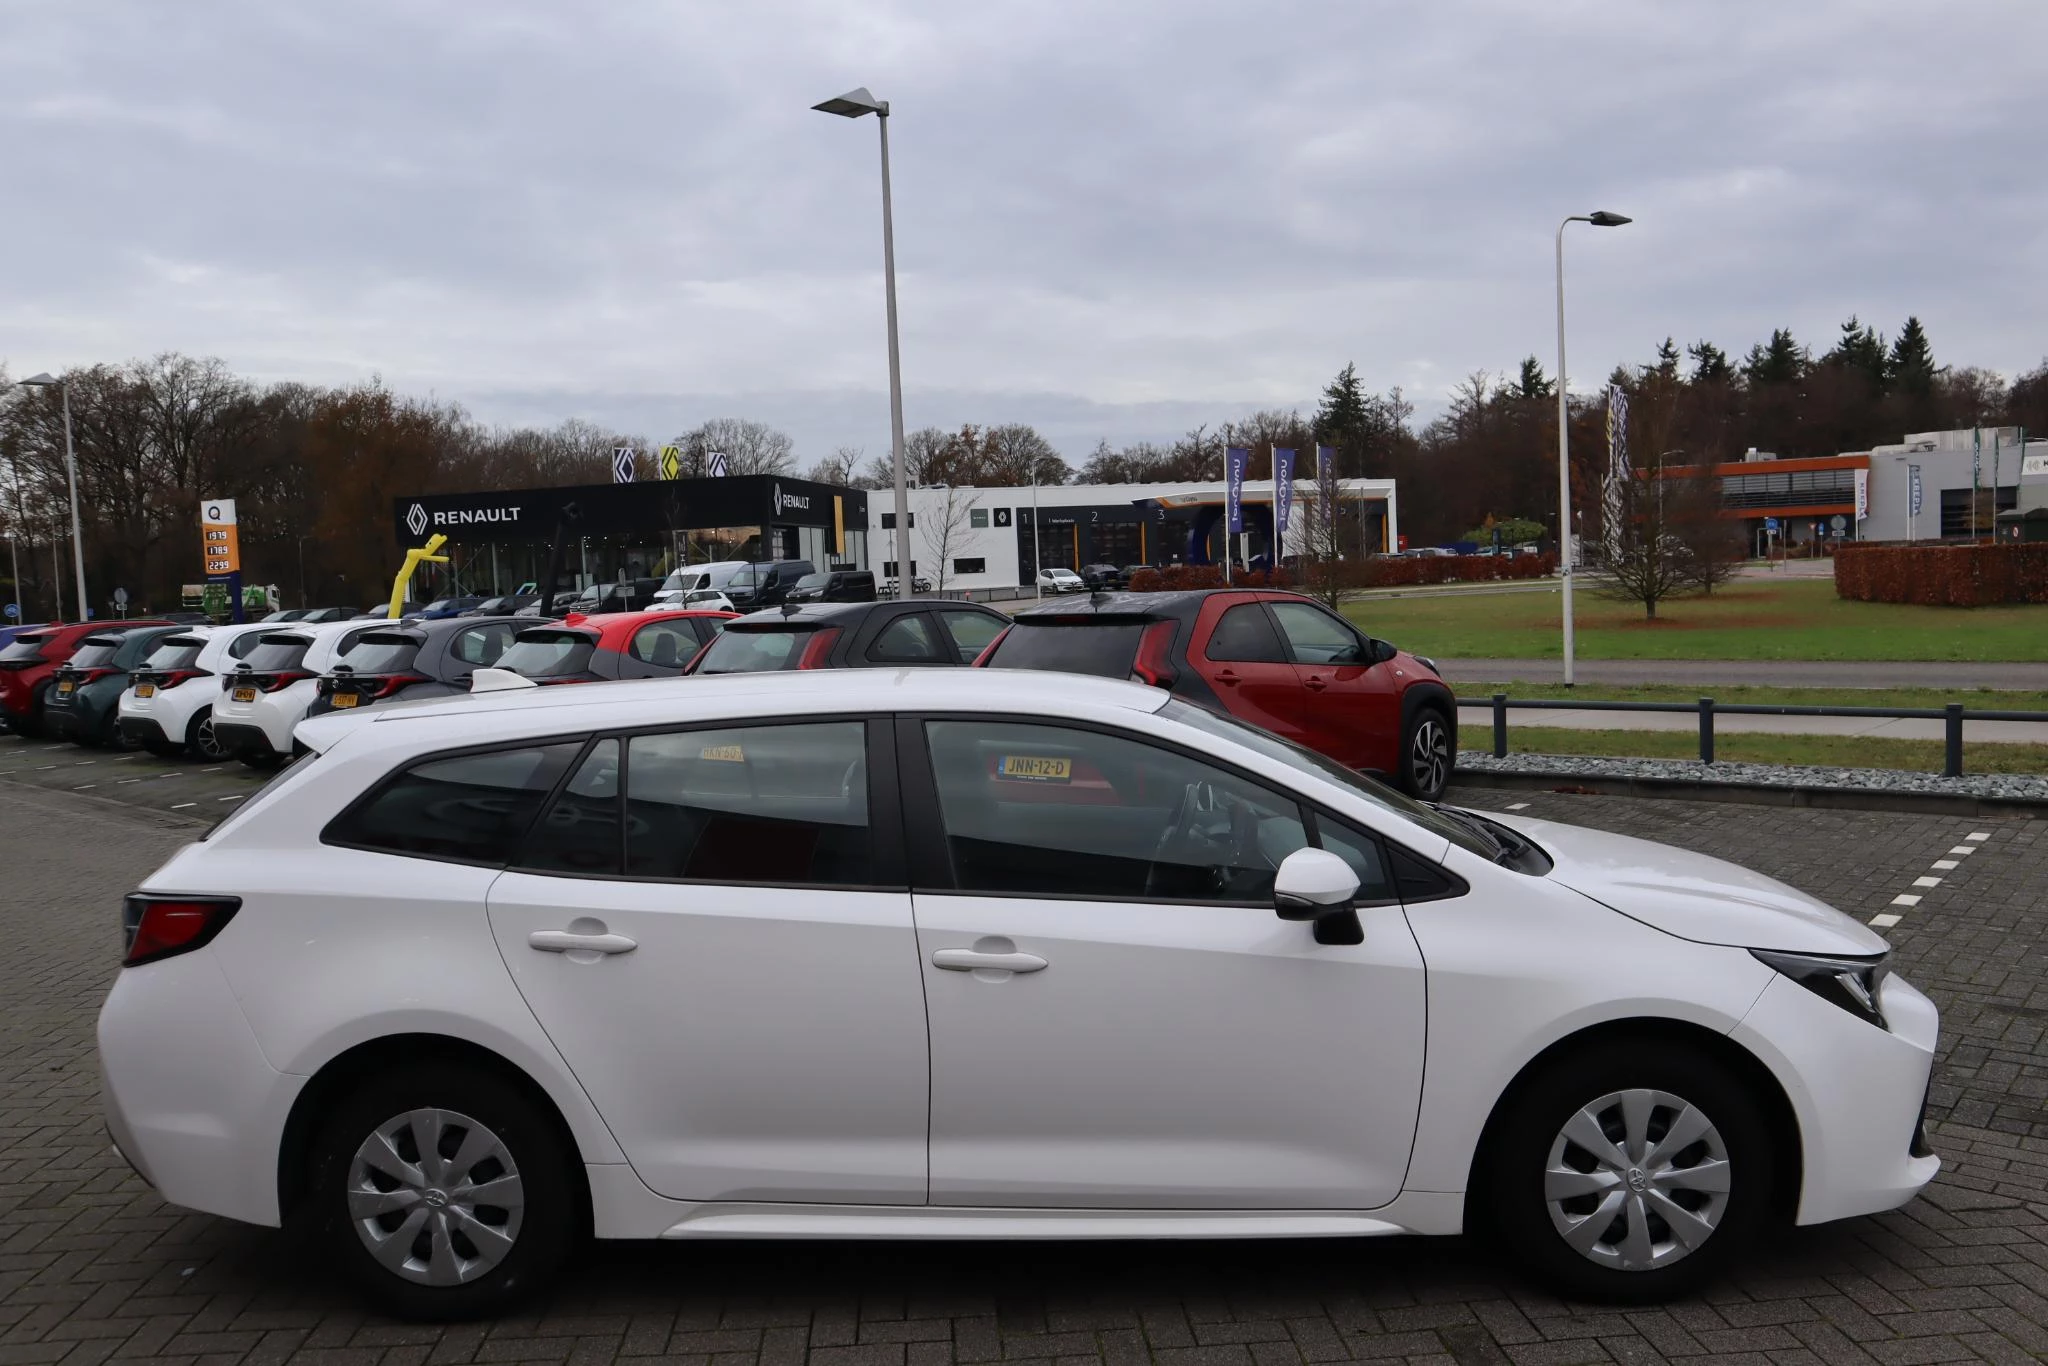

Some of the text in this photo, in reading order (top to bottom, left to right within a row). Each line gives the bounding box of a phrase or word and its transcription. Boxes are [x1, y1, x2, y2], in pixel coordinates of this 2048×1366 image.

[782, 493, 810, 510] RENAULT
[208, 505, 221, 521] Q
[433, 506, 521, 526] RENAULT
[1022, 512, 1029, 525] 1
[1091, 511, 1099, 522] 2
[1158, 509, 1166, 520] 3
[1008, 758, 1065, 776] JNN-12-D
